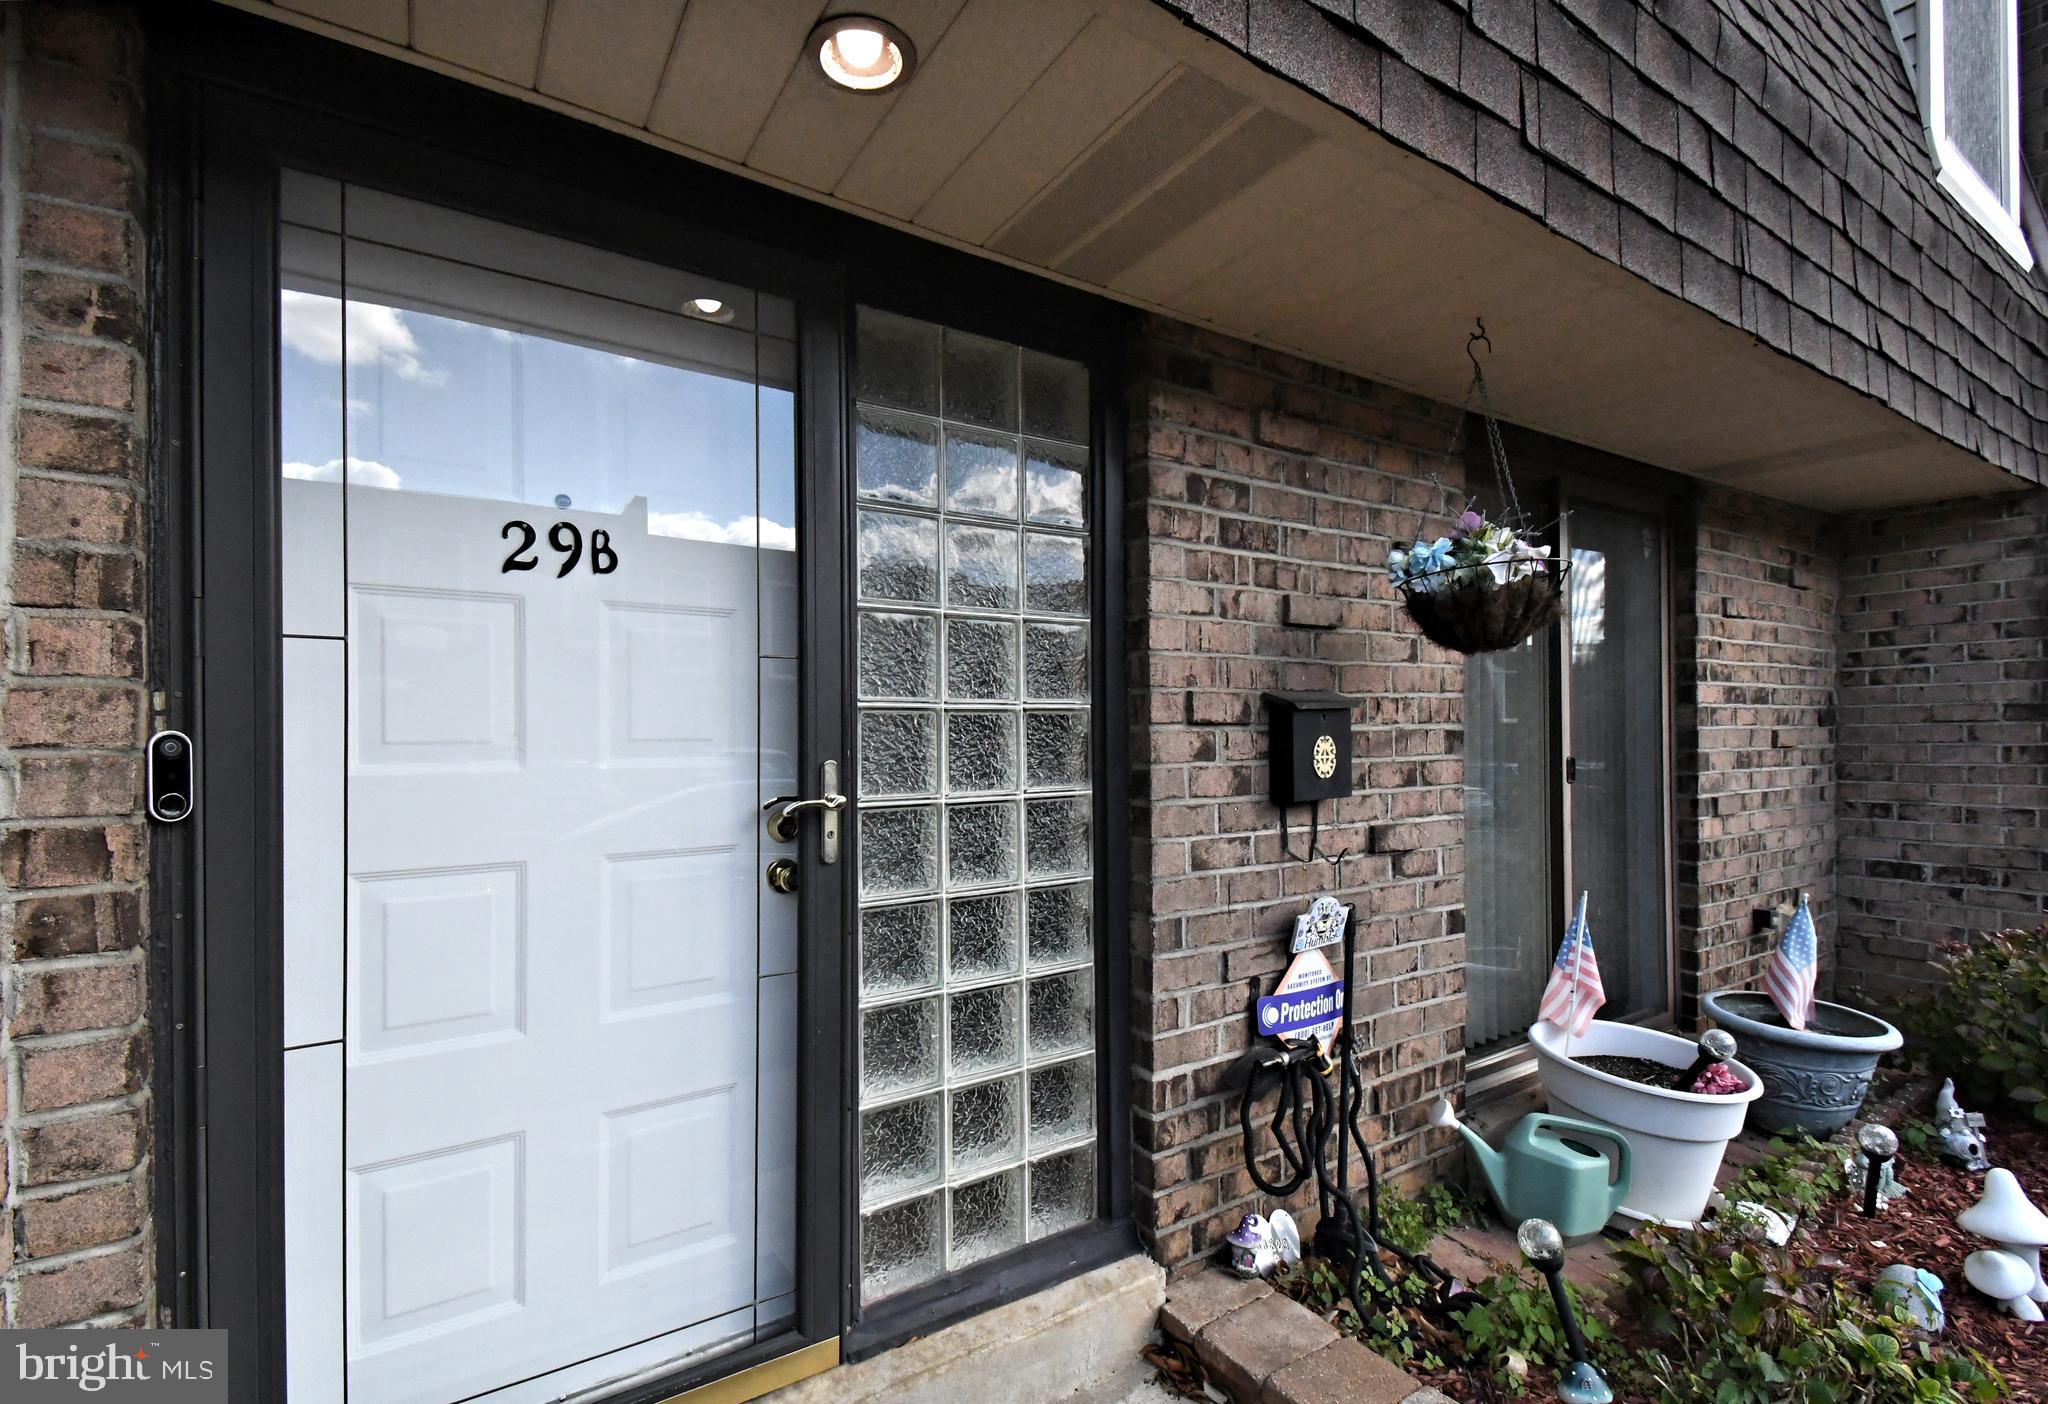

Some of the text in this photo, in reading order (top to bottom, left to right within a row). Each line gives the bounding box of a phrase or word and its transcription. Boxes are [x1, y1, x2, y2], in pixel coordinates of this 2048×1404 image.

[502, 520, 618, 578] 29B
[1287, 980, 1309, 990] SECURITY
[1310, 976, 1326, 985] SYSTEM
[1280, 988, 1344, 1024] Protection On
